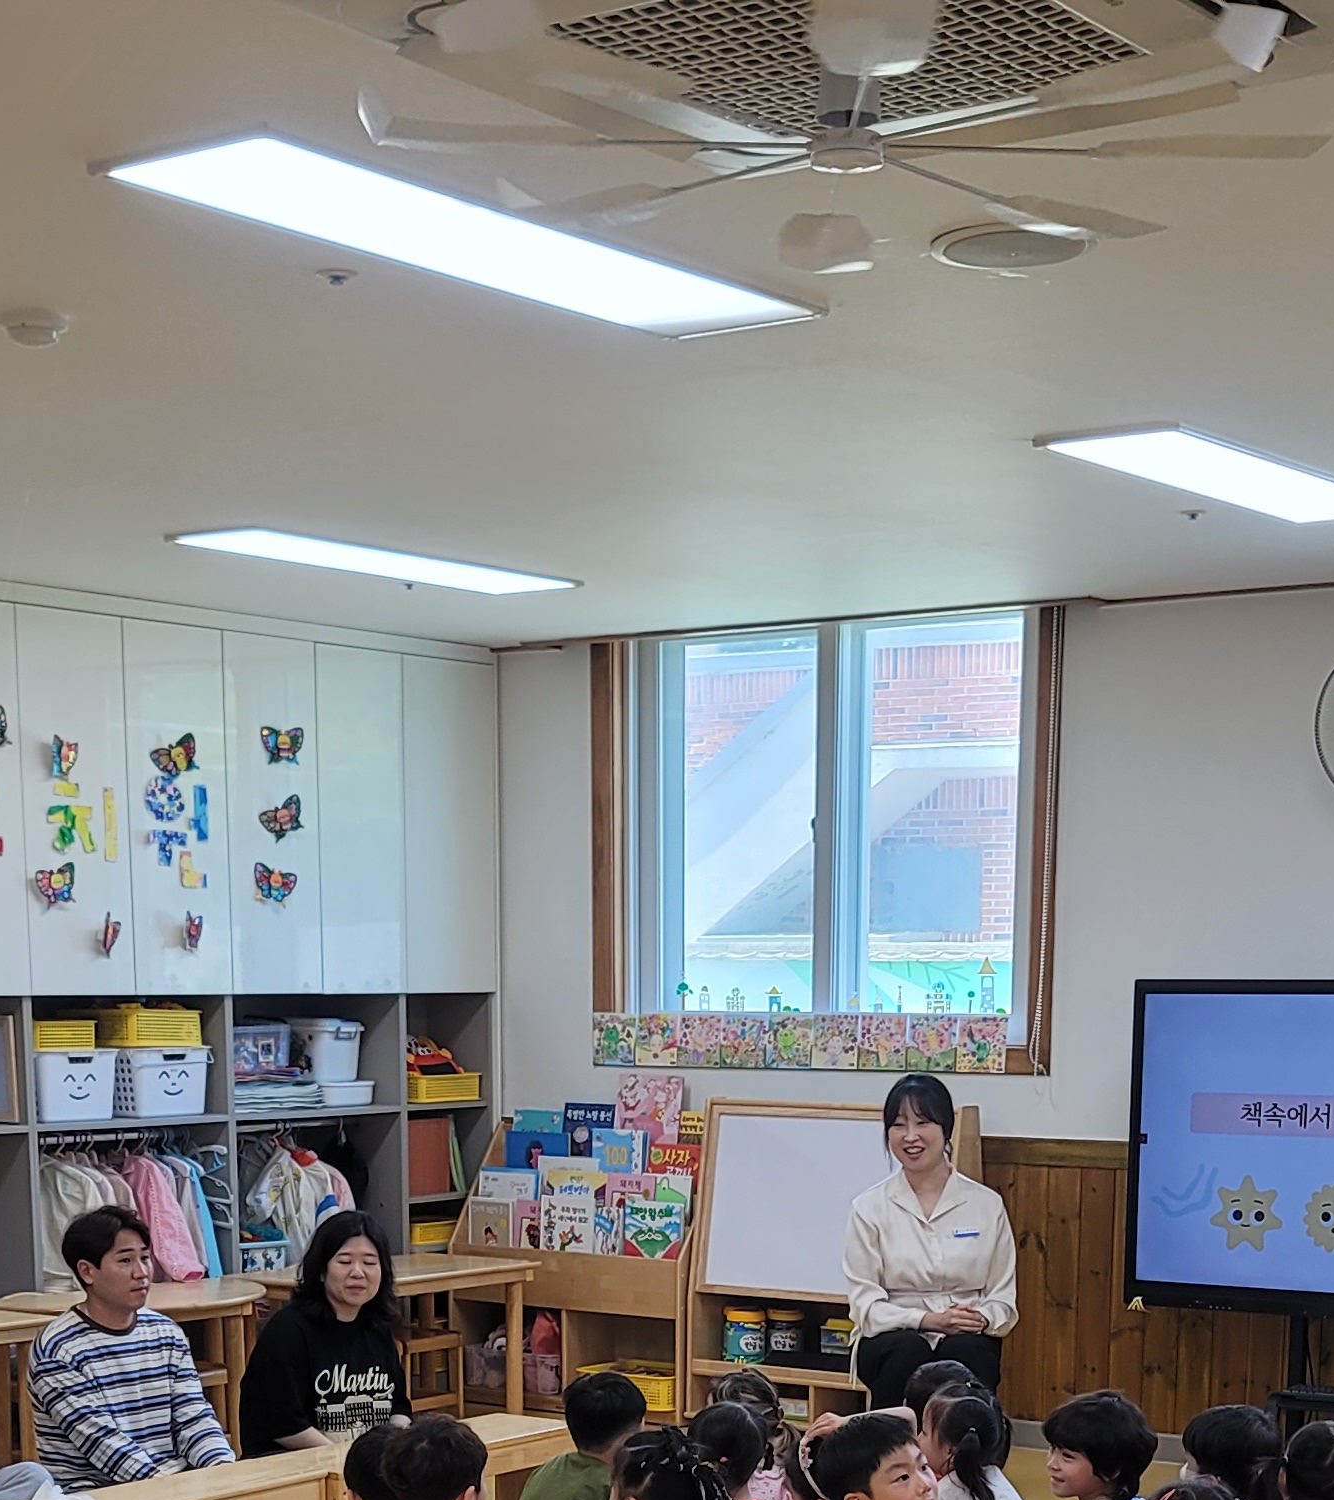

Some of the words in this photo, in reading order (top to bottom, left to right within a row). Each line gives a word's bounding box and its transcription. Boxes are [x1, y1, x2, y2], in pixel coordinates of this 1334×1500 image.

[1239, 1101, 1332, 1130] 책속에서
[662, 1148, 692, 1166] 사자
[314, 1363, 395, 1398] Martin
